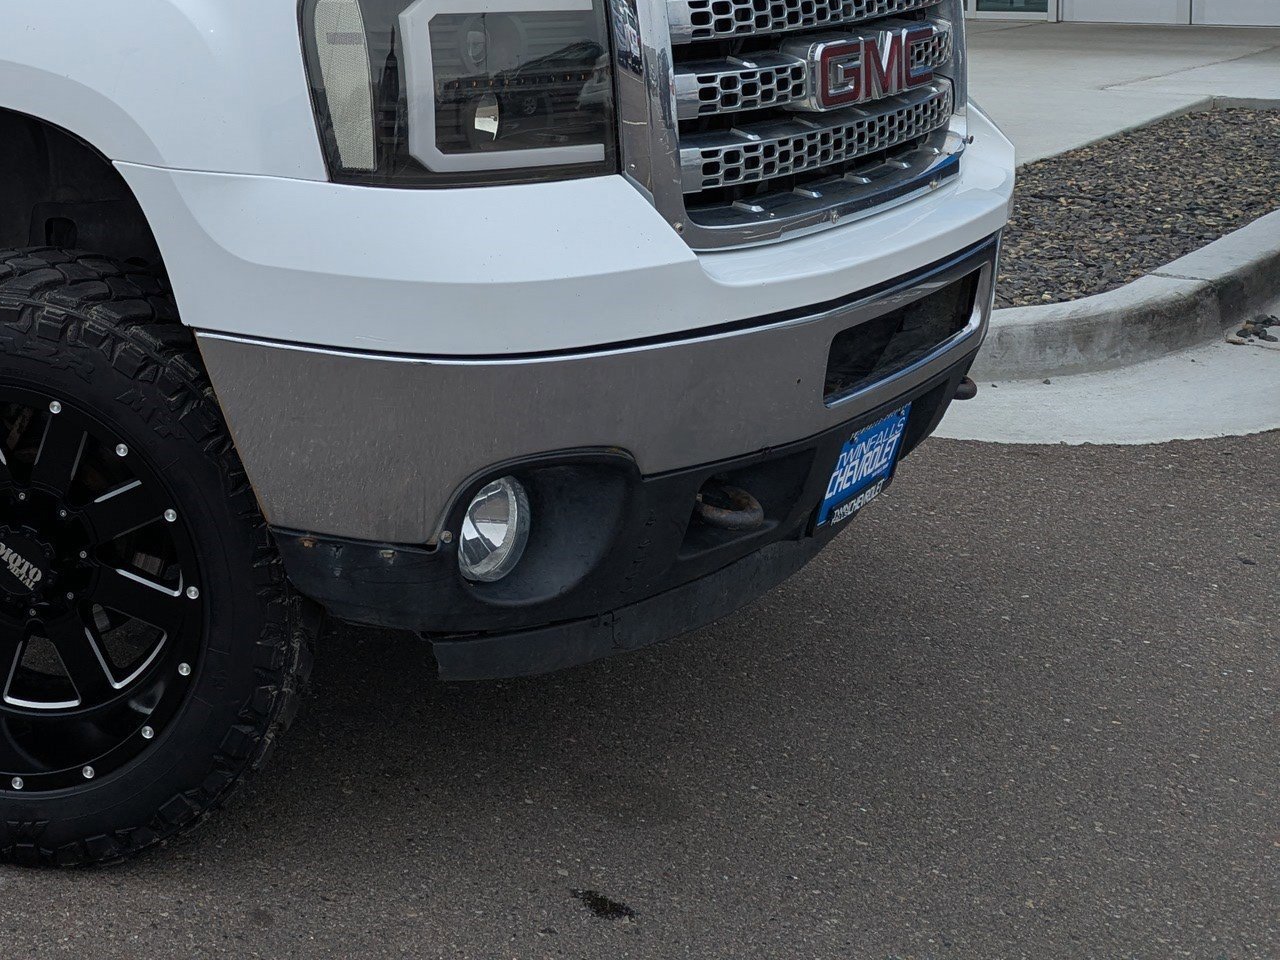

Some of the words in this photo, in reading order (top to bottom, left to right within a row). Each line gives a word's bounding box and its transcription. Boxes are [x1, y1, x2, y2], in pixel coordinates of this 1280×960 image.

[815, 24, 936, 111] GMC
[824, 432, 901, 500] CHEVROLET
[836, 417, 907, 471] TWINFALLS
[6, 563, 36, 591] METAL
